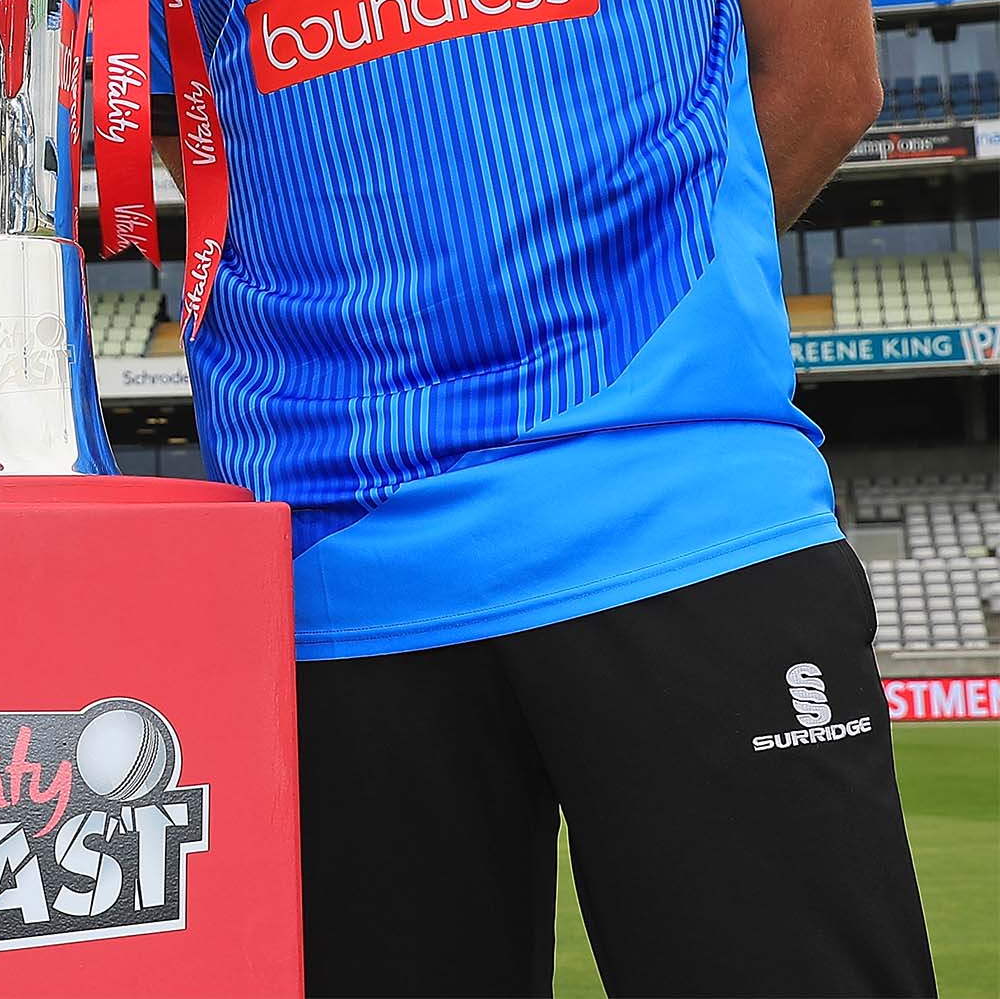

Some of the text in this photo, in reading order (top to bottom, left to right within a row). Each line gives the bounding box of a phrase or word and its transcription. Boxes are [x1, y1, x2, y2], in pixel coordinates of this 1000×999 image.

[95, 52, 148, 144] Vitality
[184, 79, 217, 166] Vitality
[882, 335, 953, 359] KING
[752, 716, 872, 752] SURRIDGE
